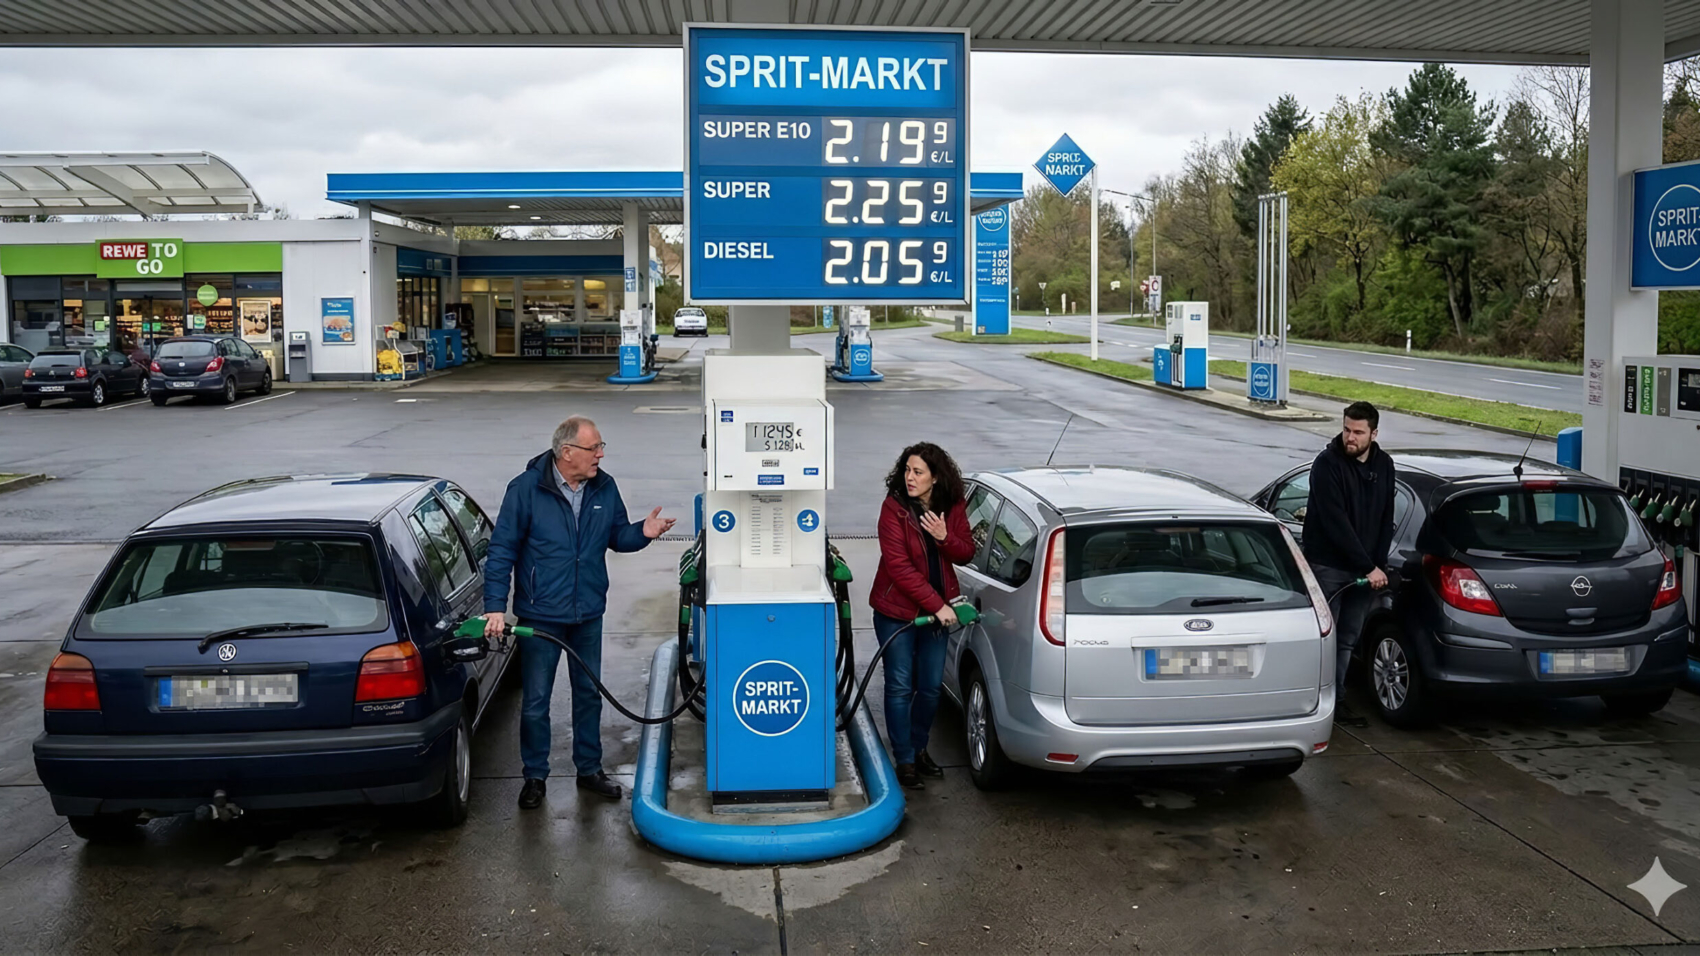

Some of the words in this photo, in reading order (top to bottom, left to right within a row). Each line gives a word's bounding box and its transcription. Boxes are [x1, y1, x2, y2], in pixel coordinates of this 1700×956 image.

[704, 54, 948, 91] SPRIT-MARKT
[703, 120, 771, 139] SUPER
[777, 121, 811, 139] E10
[930, 150, 954, 163] €/L
[703, 181, 771, 199] SUPER
[930, 210, 953, 223] €/L
[1657, 206, 1700, 227] SPRIT
[1655, 227, 1700, 248] MARK
[102, 244, 147, 258] REWE
[151, 242, 178, 258] TO
[704, 241, 774, 259] DIESEL
[136, 259, 163, 275] GO
[930, 270, 952, 283] €/L
[718, 514, 730, 529] 3
[745, 681, 799, 697] SPRIT-
[741, 699, 802, 715] MARKT
